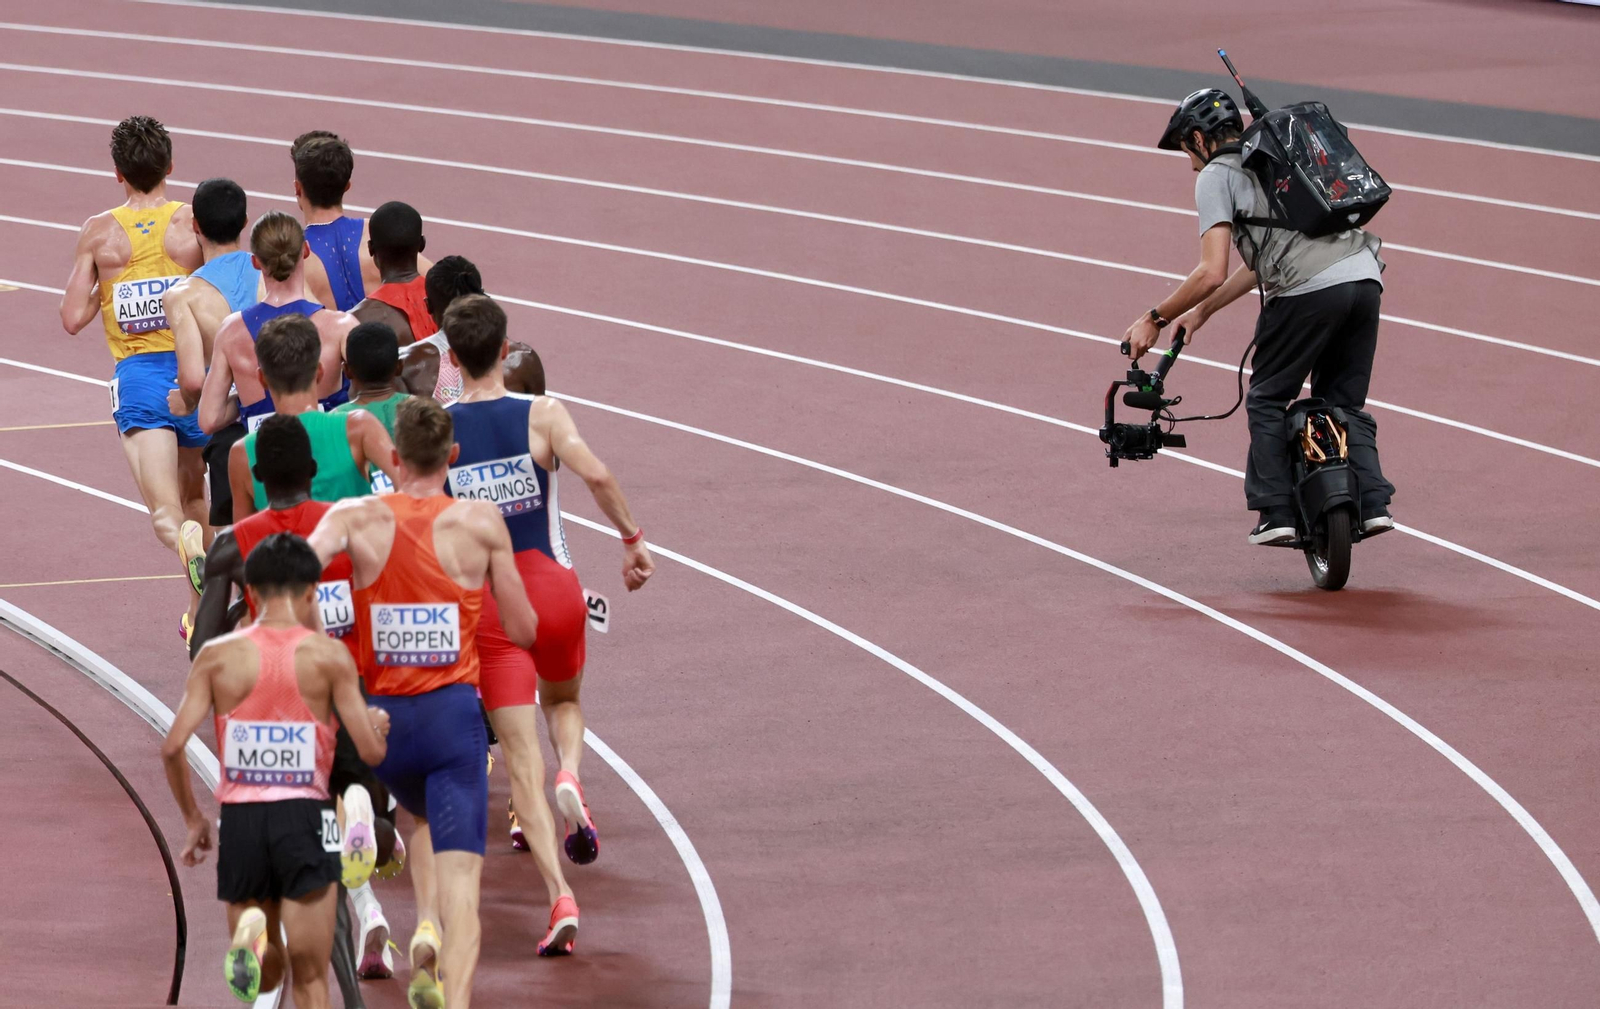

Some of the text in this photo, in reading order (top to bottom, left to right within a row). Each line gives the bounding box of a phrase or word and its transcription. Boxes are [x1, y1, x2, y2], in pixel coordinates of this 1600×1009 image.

[134, 319, 170, 330] TOKY
[471, 458, 529, 482] TDK
[393, 606, 450, 625] TDK
[587, 595, 607, 623] 15
[377, 630, 453, 649] FOPPEN
[248, 725, 307, 744] TDK
[238, 748, 300, 768] MORI
[324, 817, 340, 845] 20
